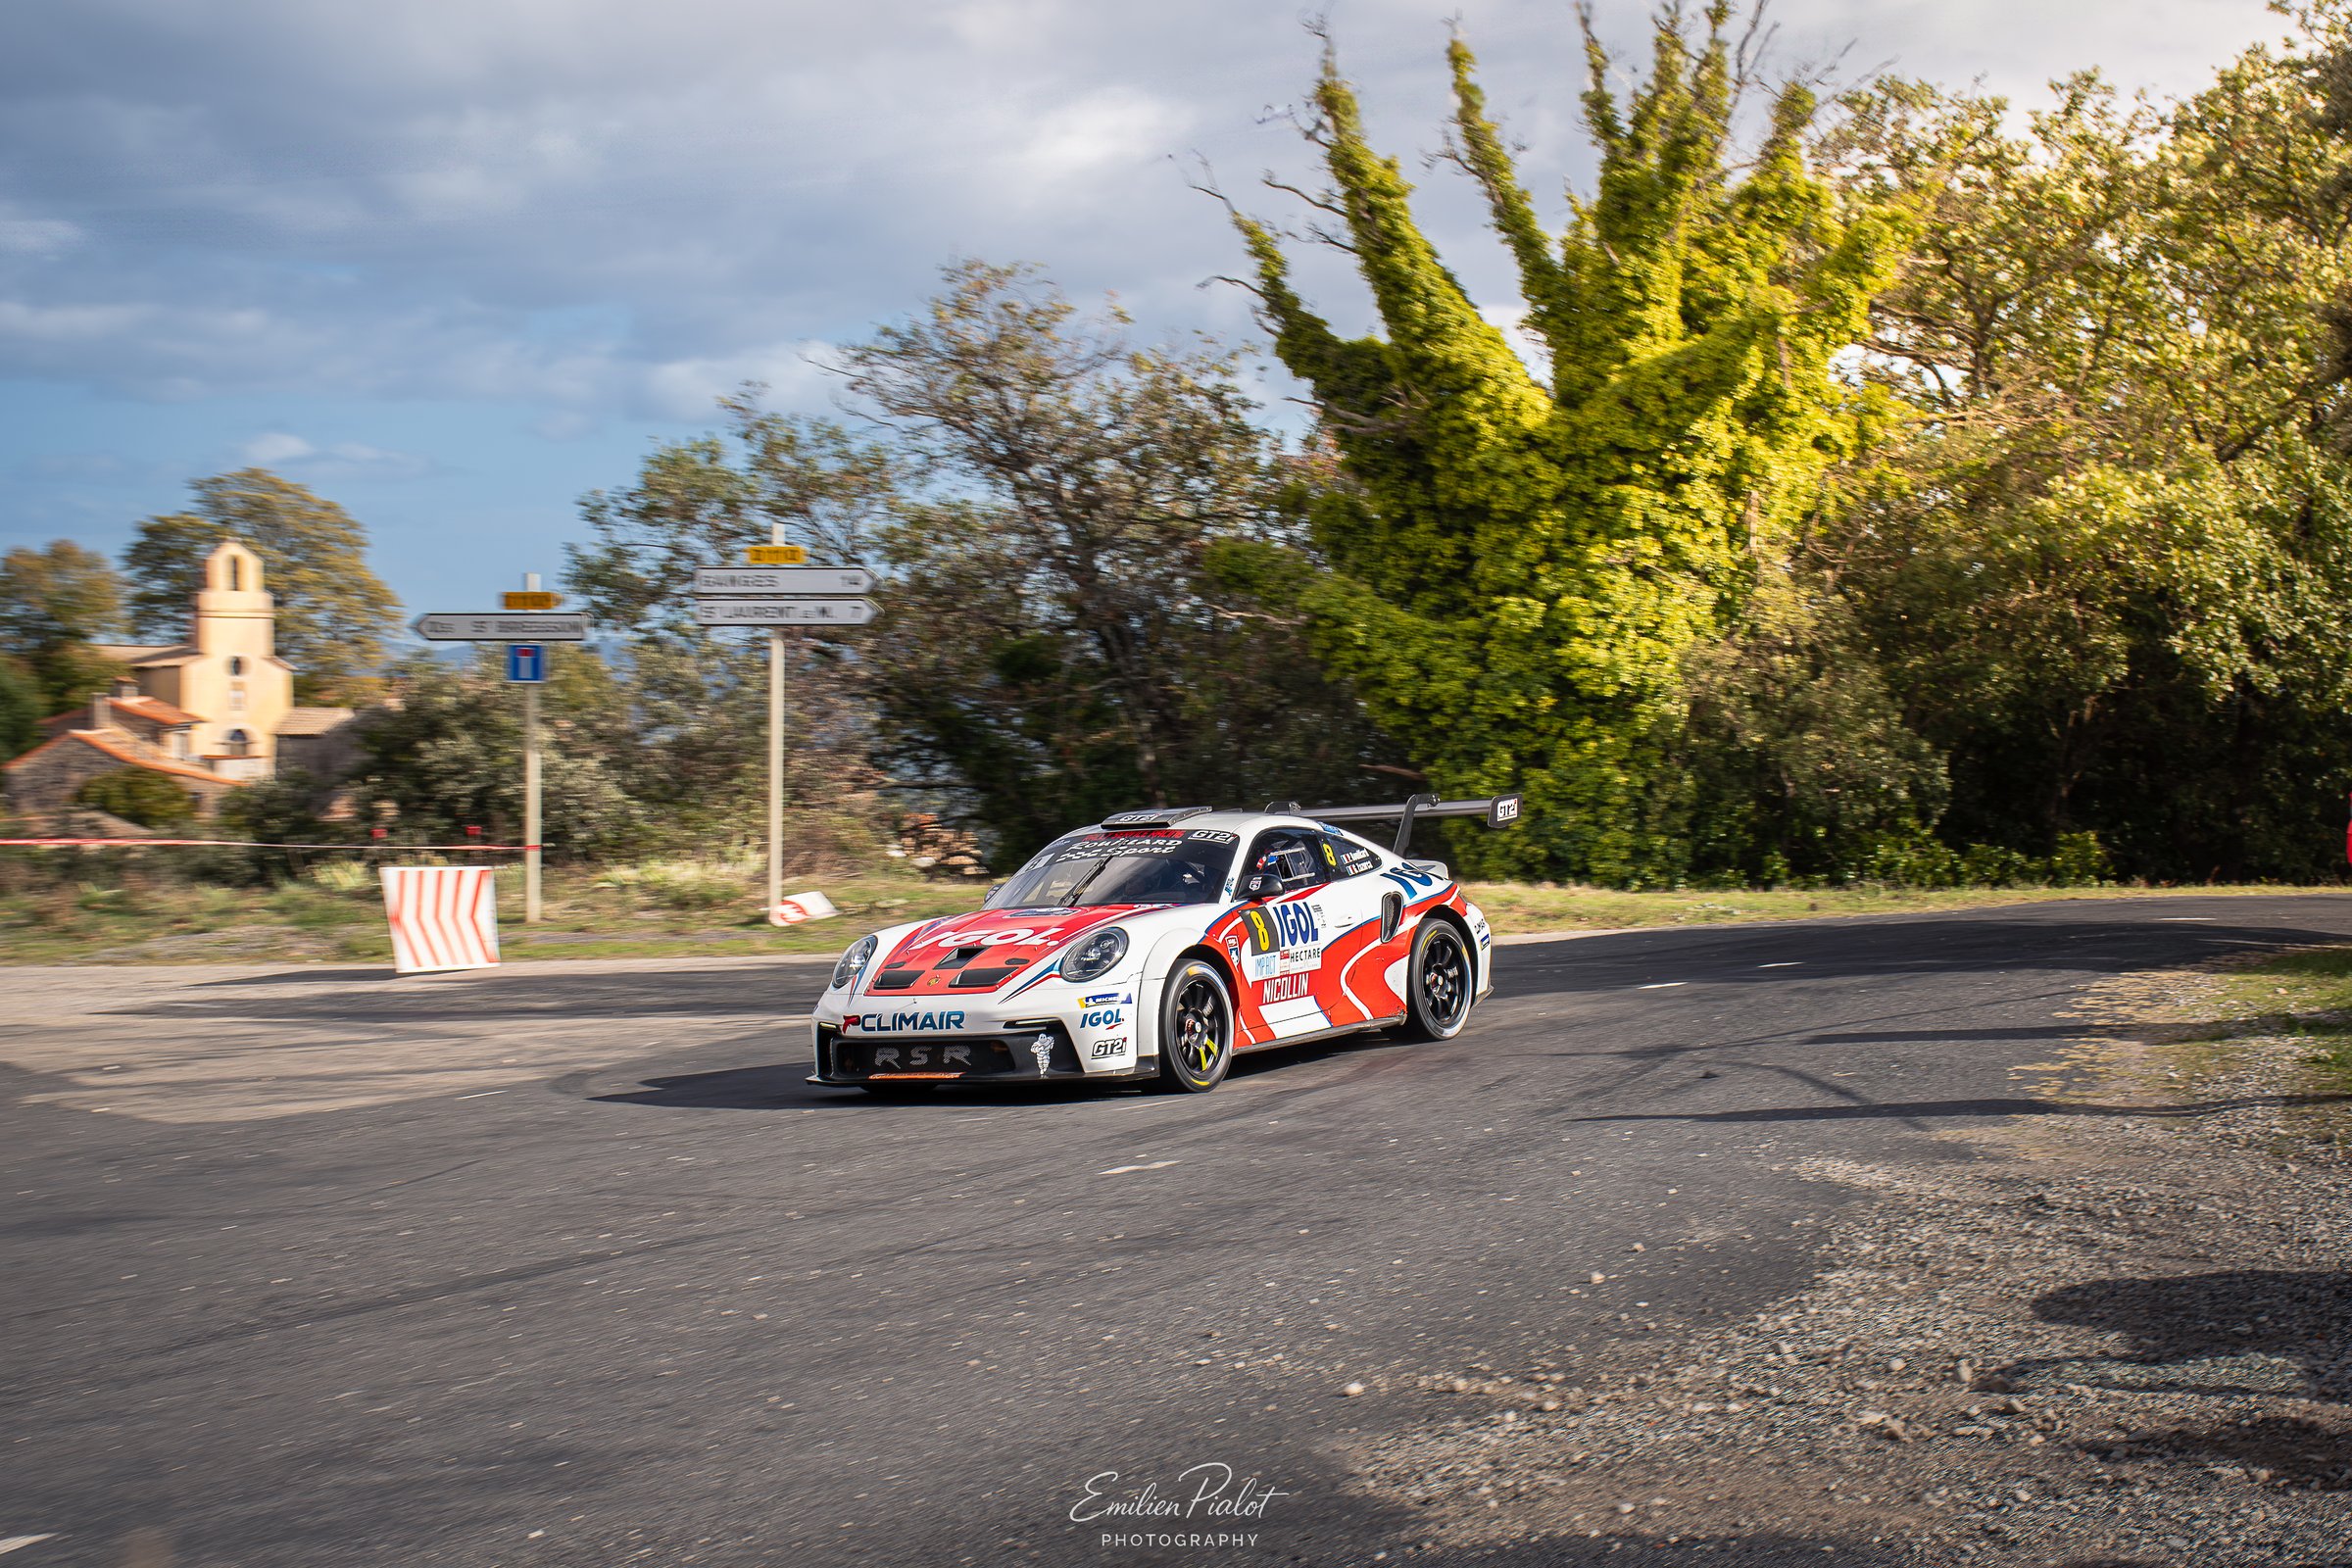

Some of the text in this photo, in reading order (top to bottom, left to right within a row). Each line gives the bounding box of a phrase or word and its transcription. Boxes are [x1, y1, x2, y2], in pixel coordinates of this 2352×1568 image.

[1193, 830, 1239, 844] GT2i
[1323, 843, 1337, 867] 8
[1250, 909, 1270, 952] 8
[1272, 901, 1319, 948] IGOL
[1290, 948, 1321, 962] HECTARE
[1262, 972, 1309, 1004] NICOLLIN
[1091, 1037, 1127, 1057] GT2i
